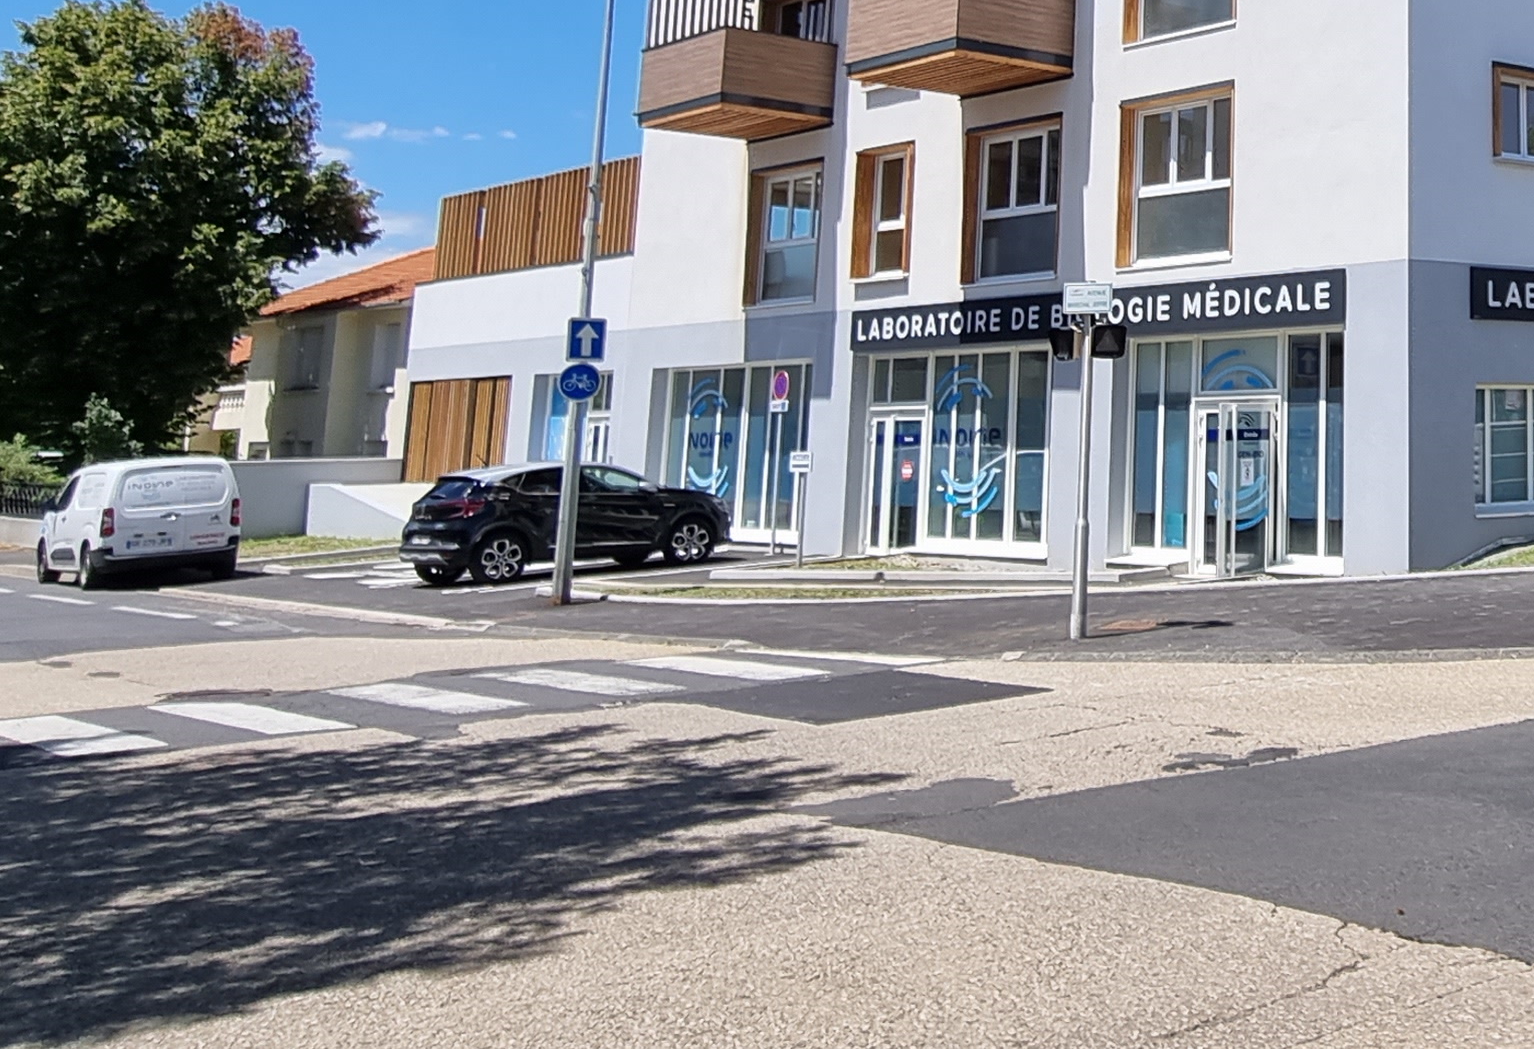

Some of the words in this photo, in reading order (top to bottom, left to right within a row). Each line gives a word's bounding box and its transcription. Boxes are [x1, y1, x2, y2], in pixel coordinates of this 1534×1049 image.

[857, 309, 1001, 342] LABORATOIRE
[1011, 305, 1041, 331] DE
[1051, 294, 1171, 329] BOGIE
[1182, 281, 1332, 320] MÉDICALE
